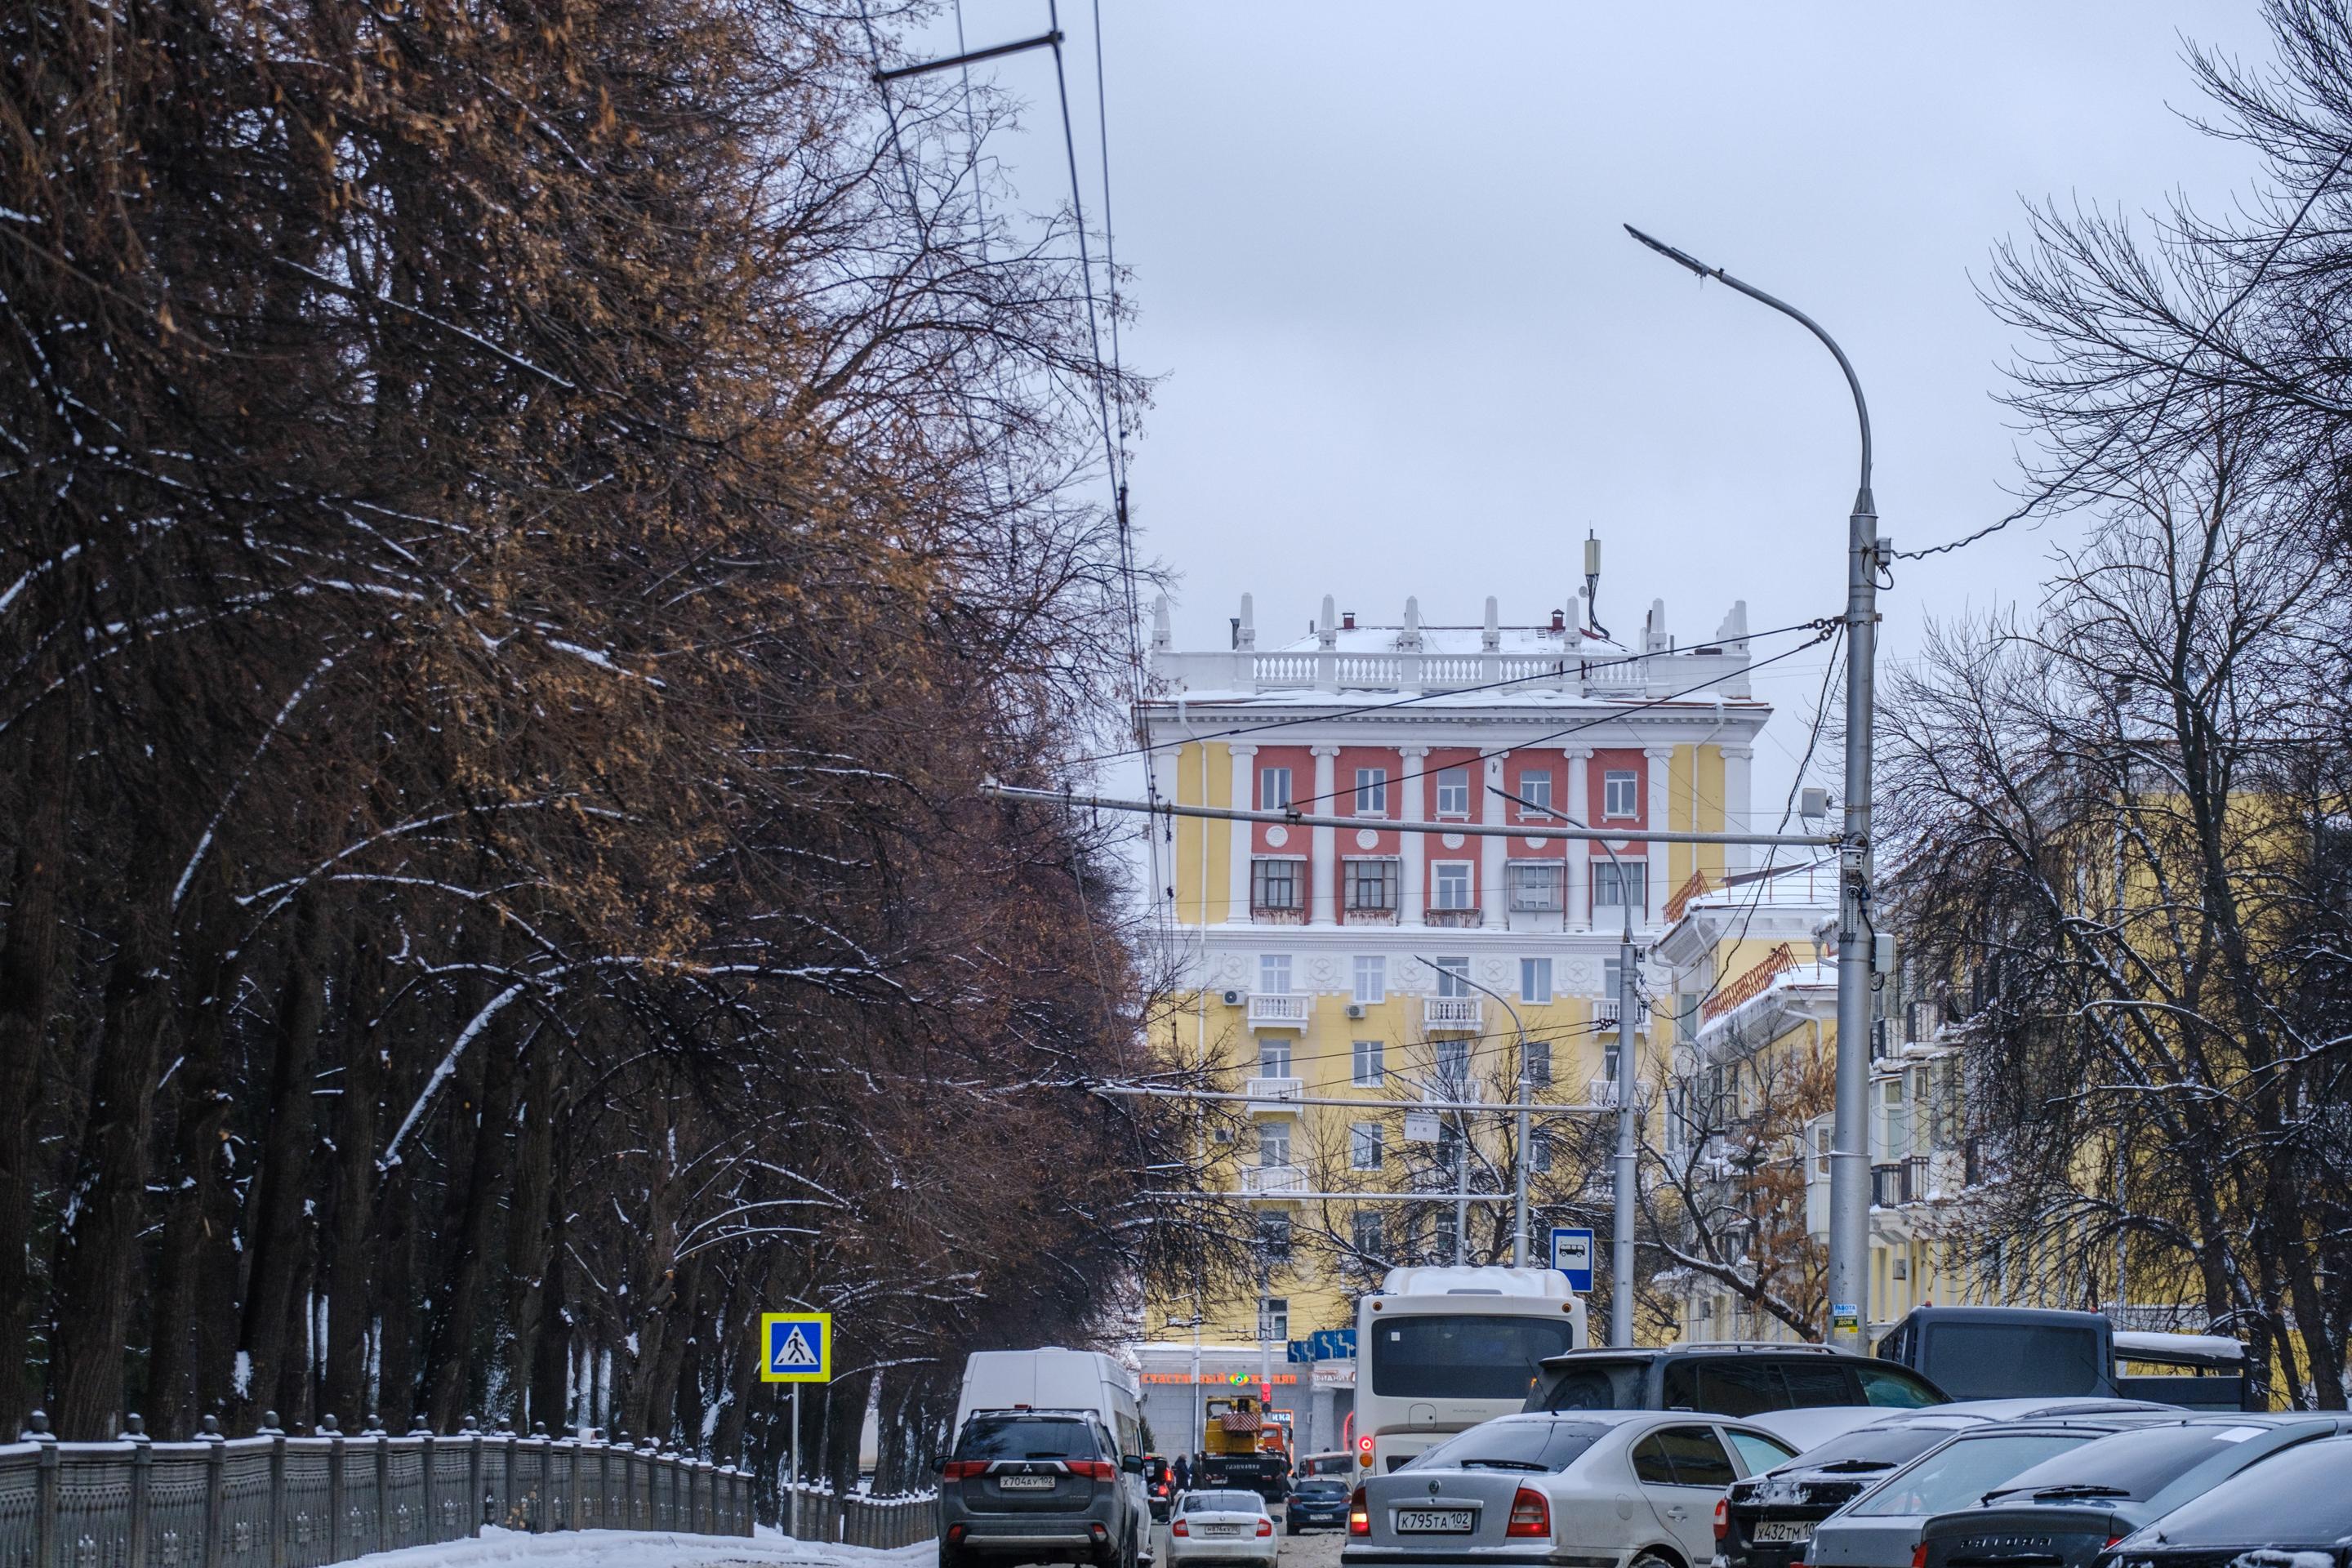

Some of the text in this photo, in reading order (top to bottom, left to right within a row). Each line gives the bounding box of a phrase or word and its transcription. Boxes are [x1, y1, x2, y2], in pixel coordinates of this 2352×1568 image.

[1401, 1513, 1468, 1528] К795ТА 102
[1757, 1524, 1801, 1540] Х432ТМ
